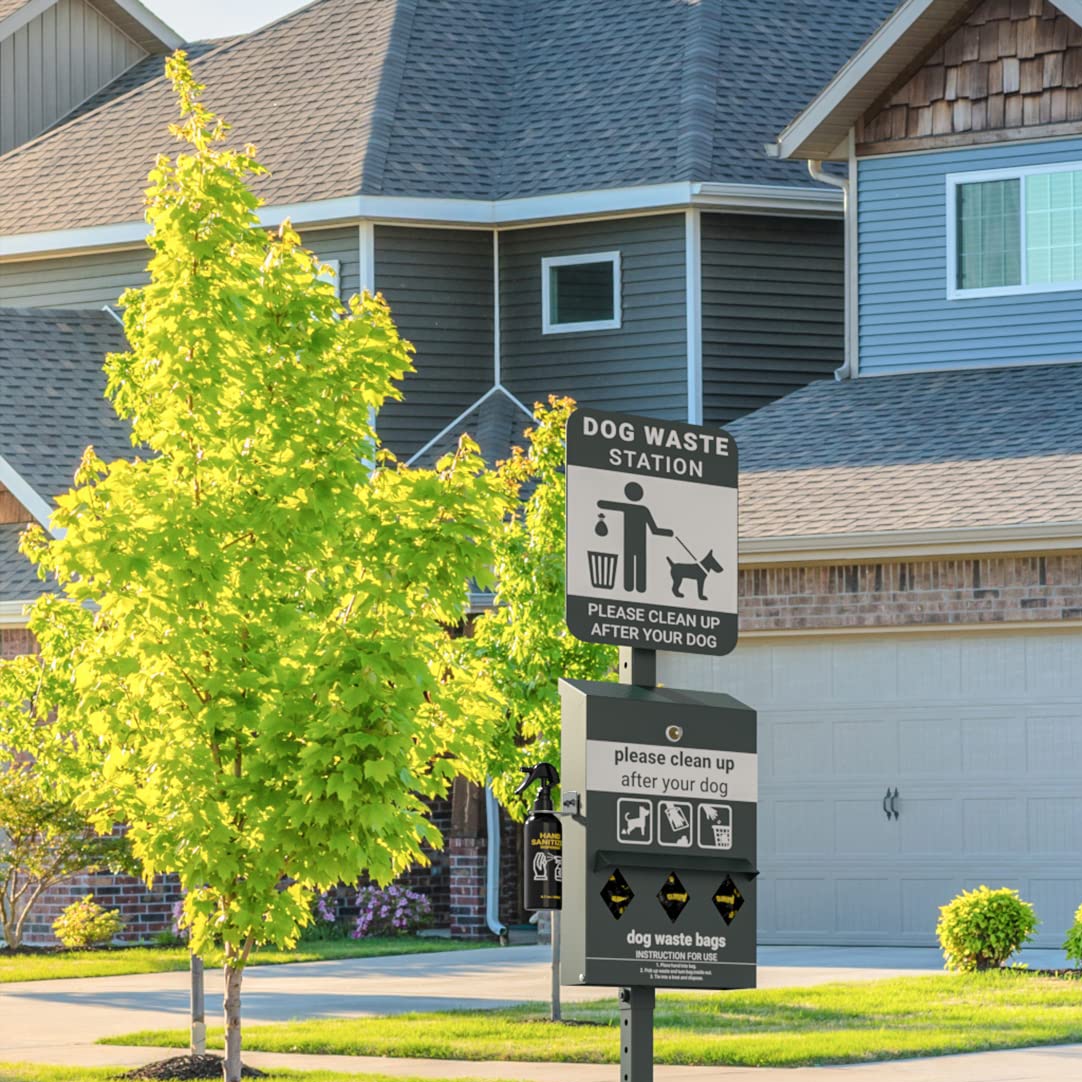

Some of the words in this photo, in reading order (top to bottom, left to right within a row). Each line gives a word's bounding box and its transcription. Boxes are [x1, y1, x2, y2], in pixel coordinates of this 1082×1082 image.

[583, 416, 635, 442] DOG
[643, 425, 729, 456] WASTE
[609, 448, 703, 478] STATION
[588, 602, 645, 622] PLEASE
[649, 609, 697, 628] CLEAN
[700, 615, 720, 630] UP
[591, 622, 639, 641] AFTER
[643, 627, 682, 645] YOUR
[686, 633, 717, 648] DOG
[614, 746, 665, 765] please
[671, 749, 711, 769] clean
[716, 756, 735, 773] up
[620, 771, 658, 789] after
[662, 776, 695, 793] your
[700, 777, 728, 797] dog
[626, 929, 652, 948] dog
[654, 932, 693, 946] waste
[695, 931, 726, 951] bags
[635, 950, 686, 960] INSTRUCTION
[687, 952, 702, 961] FOR
[703, 953, 718, 962] USE
